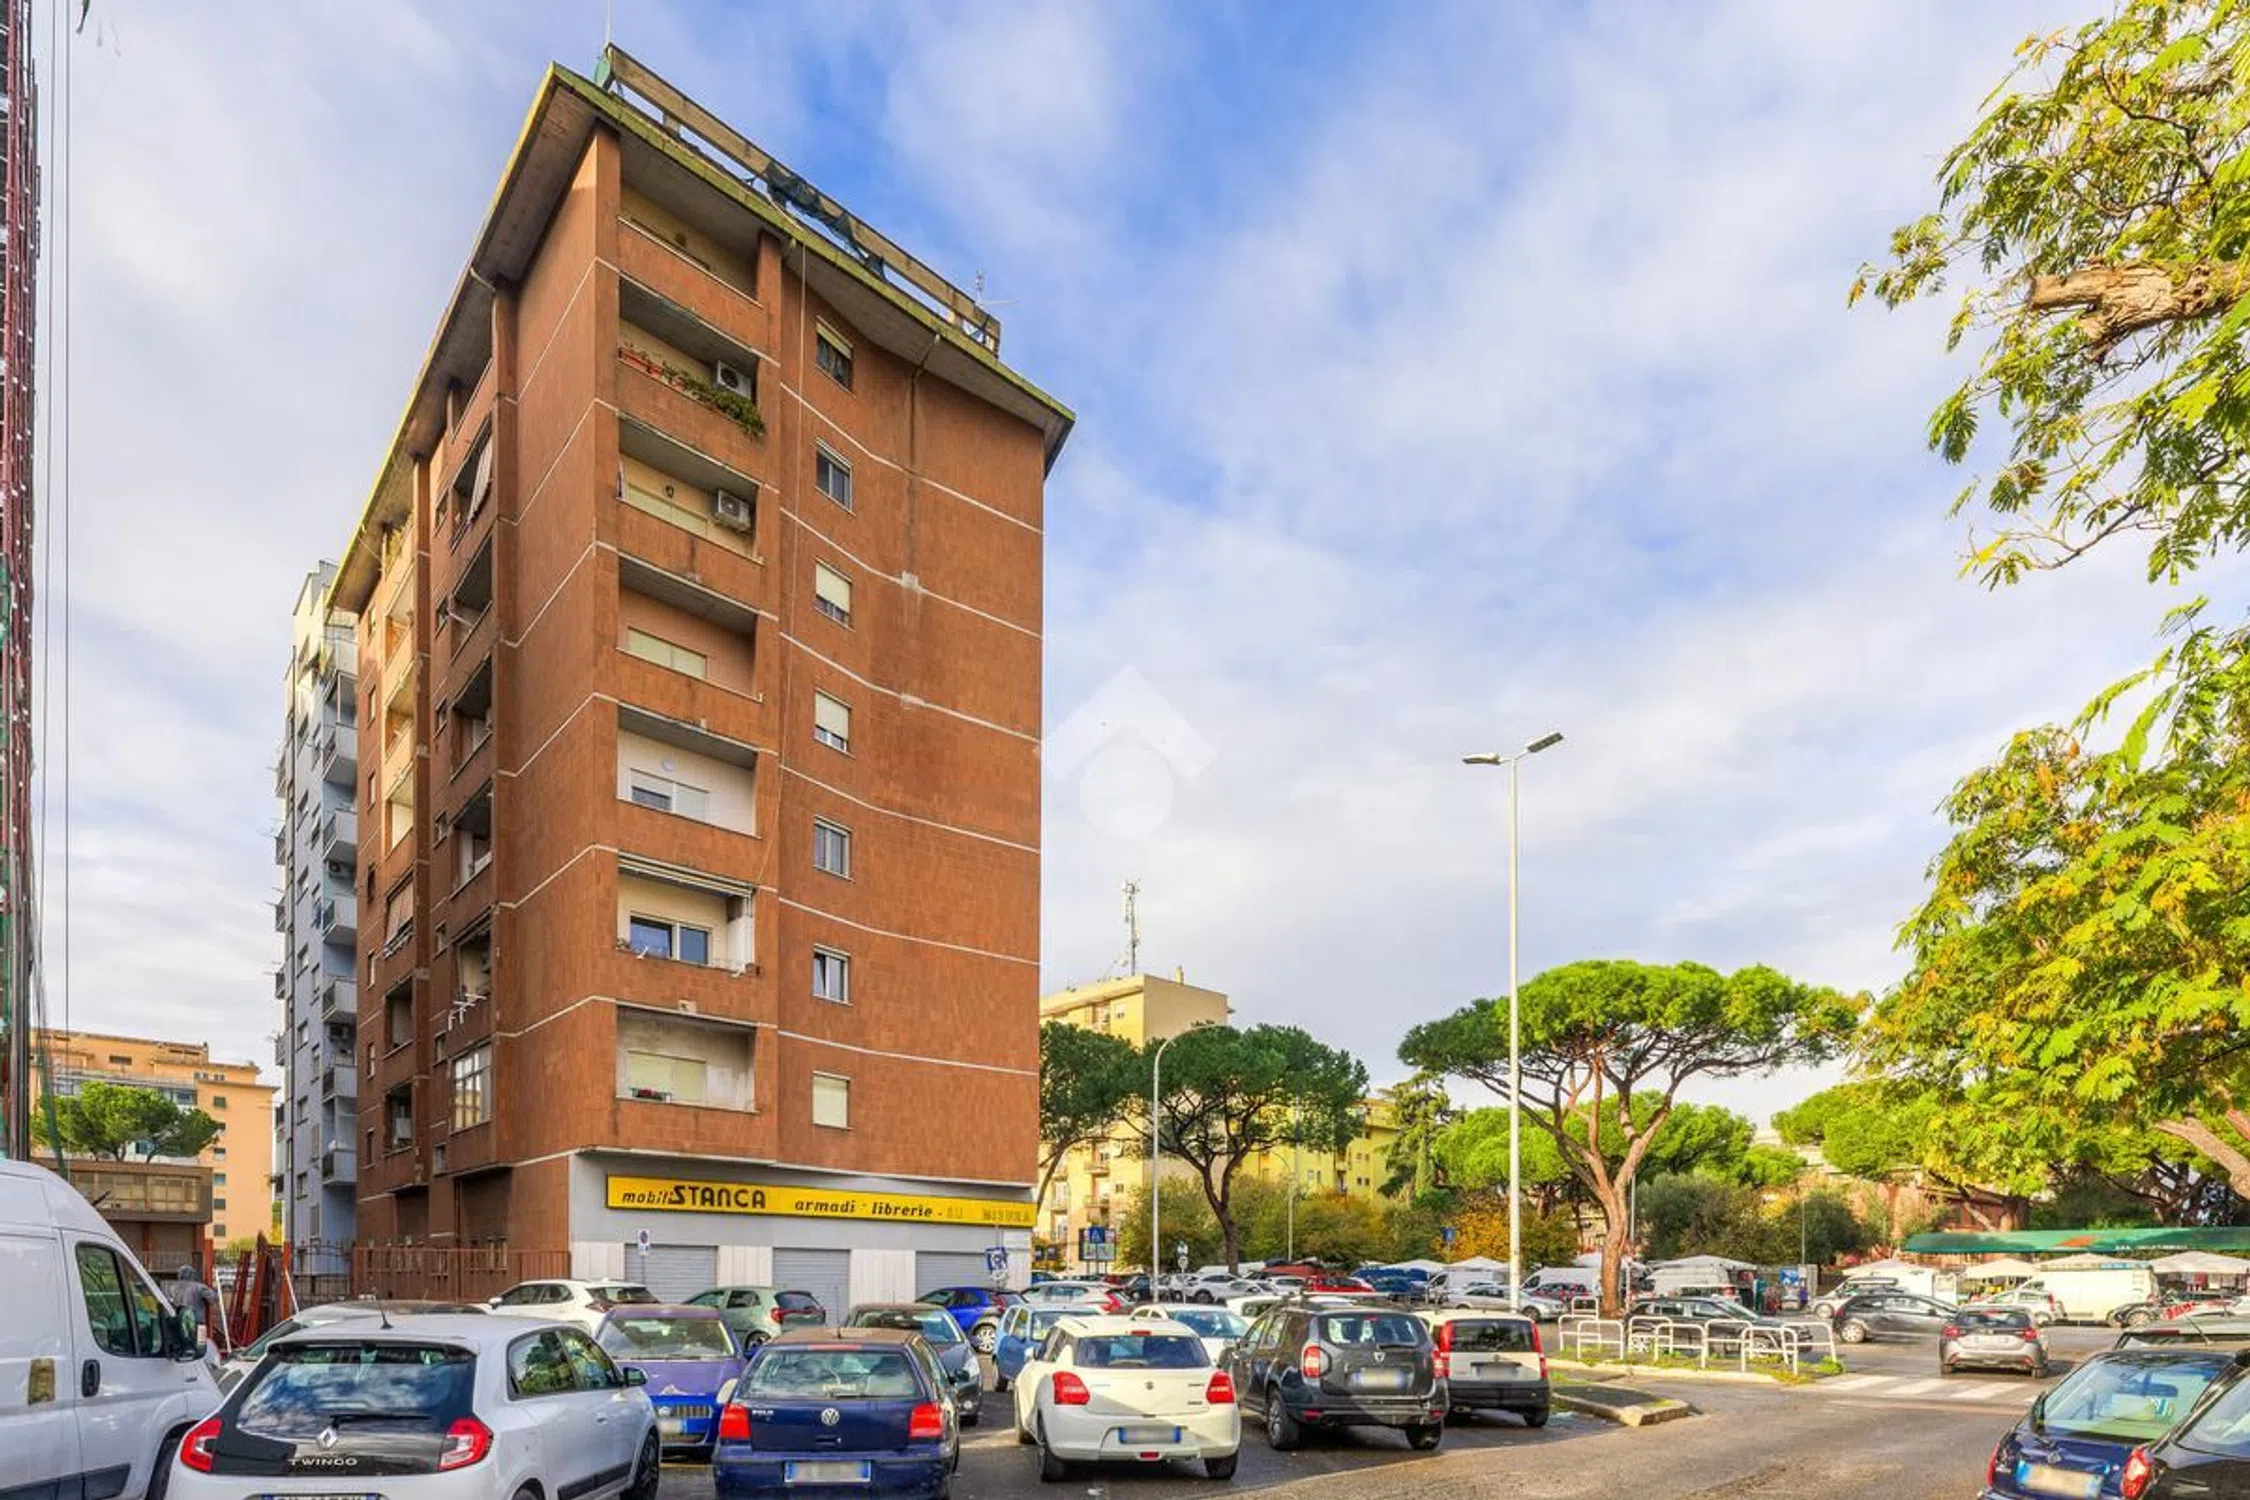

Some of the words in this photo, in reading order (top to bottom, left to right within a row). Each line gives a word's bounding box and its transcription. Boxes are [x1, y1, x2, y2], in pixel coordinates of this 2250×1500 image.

[668, 1185, 766, 1209] STANCA
[794, 1199, 856, 1214] armadi
[871, 1201, 933, 1217] librerie
[288, 1457, 358, 1466] TWINGO
